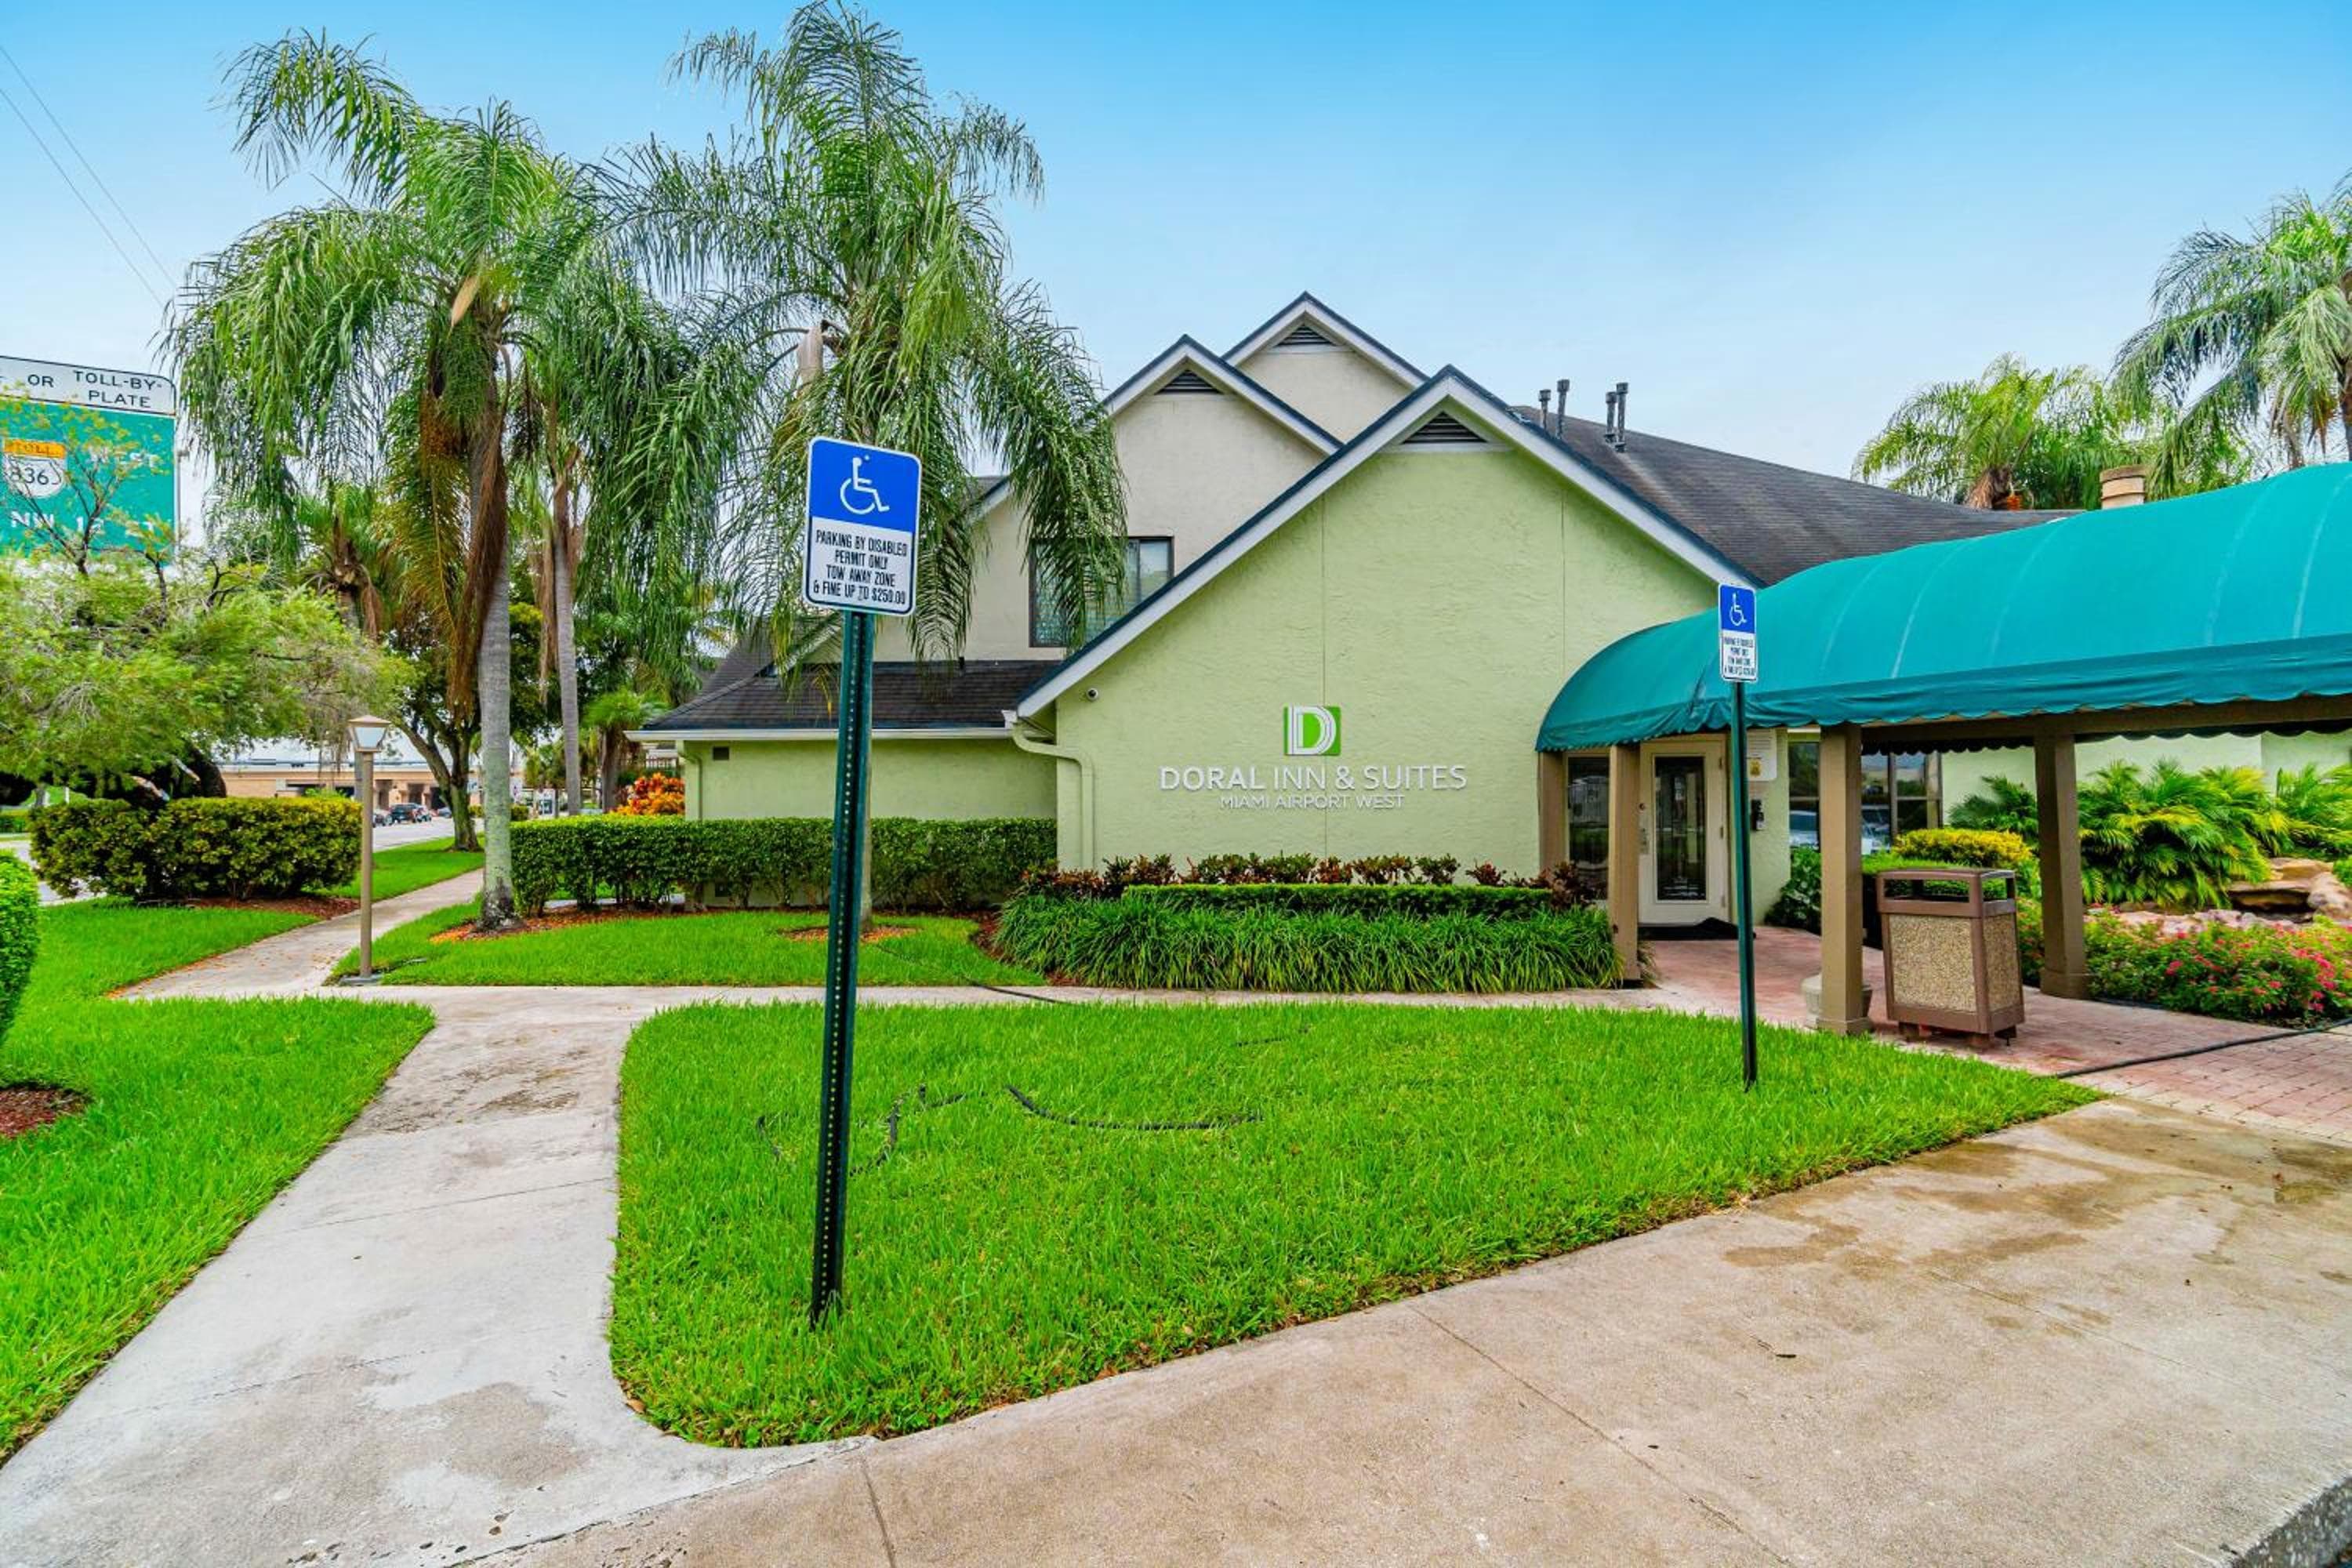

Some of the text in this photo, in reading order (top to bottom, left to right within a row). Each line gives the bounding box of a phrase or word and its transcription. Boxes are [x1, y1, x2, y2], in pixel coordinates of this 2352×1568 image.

[27, 374, 54, 388] OR
[89, 390, 151, 408] PLATE
[11, 510, 55, 528] NW
[815, 530, 908, 557] PARKING BY DISABLED
[835, 550, 888, 570] PERMIT ONLY
[826, 564, 896, 587] TOW AWAY ZONE
[813, 579, 906, 605] & FINE UP TO $250.00
[1160, 764, 1467, 791] DORAL INN & SUITES
[1219, 794, 1405, 810] MIAMI AIRPORT WEST
